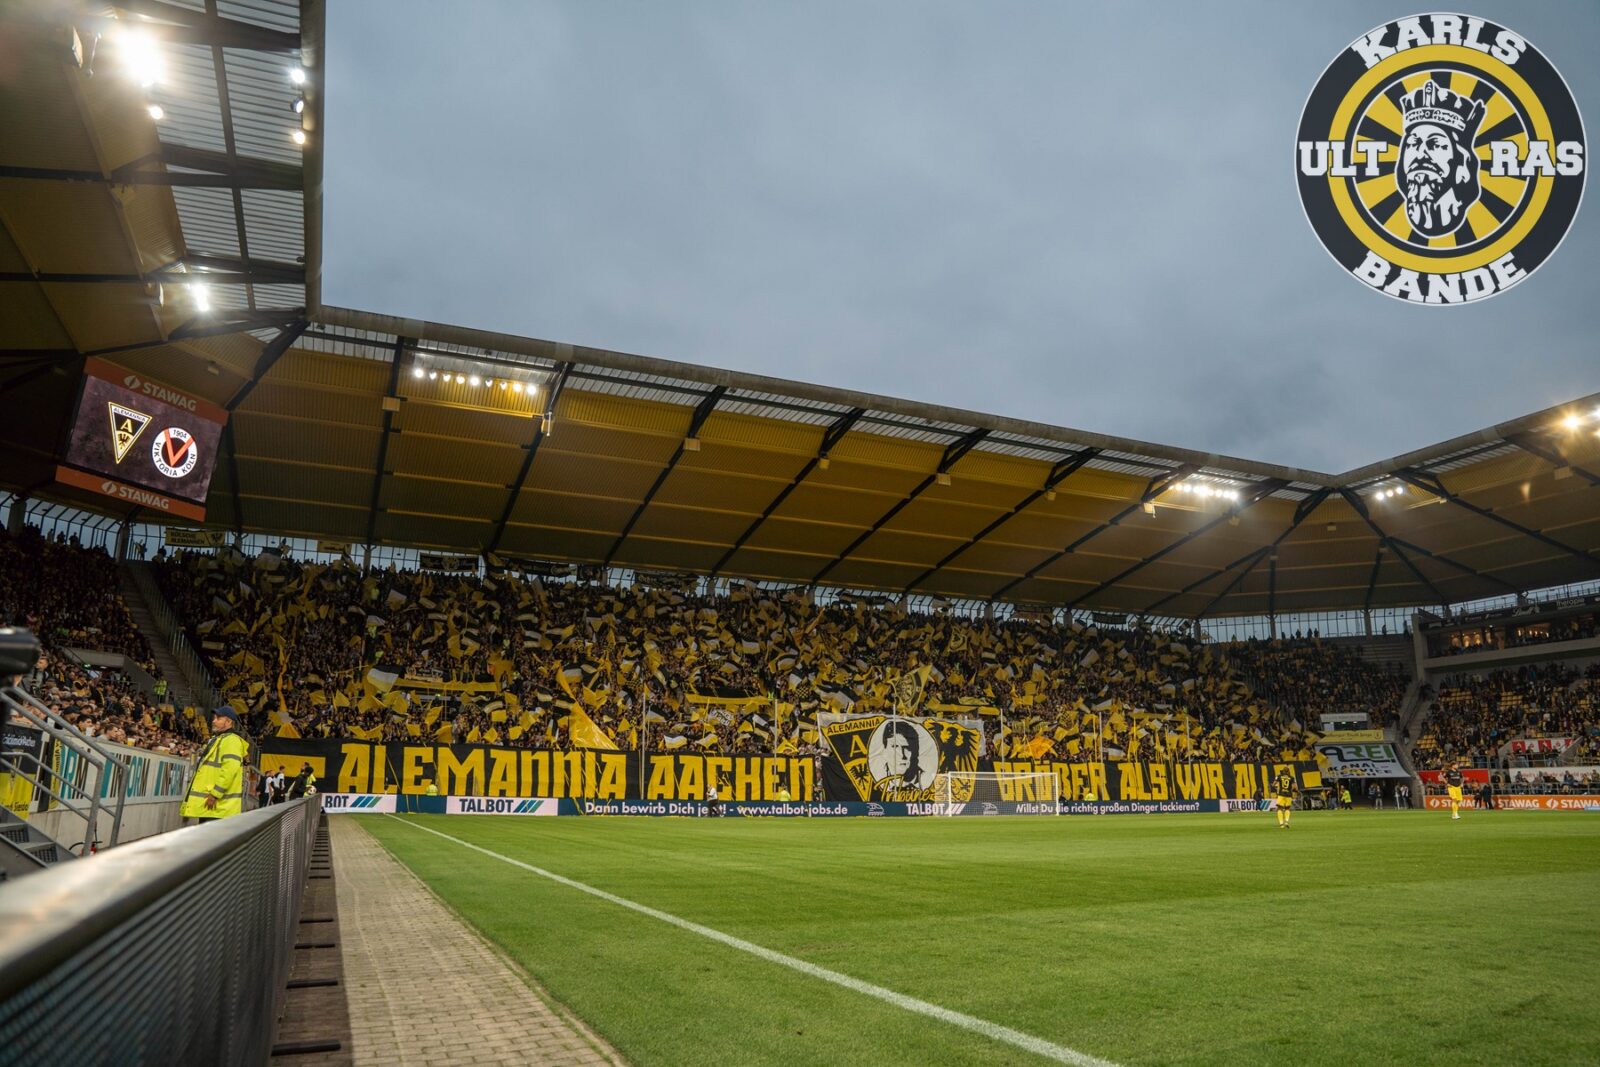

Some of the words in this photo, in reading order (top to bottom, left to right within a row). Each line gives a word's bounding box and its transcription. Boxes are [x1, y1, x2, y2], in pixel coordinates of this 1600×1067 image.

[143, 382, 198, 412] STAWAG
[173, 429, 188, 440] 1904
[154, 442, 178, 477] VIKTORIA
[119, 486, 170, 510] STAWAG
[827, 719, 881, 734] ALEMANNIA
[337, 743, 627, 800] ALEMANNIA
[647, 754, 813, 801] AACHEN
[1117, 762, 1169, 801] ALS
[1175, 762, 1227, 800] WIR
[1281, 777, 1290, 789] 19
[459, 799, 514, 813] TALBOT
[585, 802, 618, 814] Dann
[622, 802, 666, 814] bewirb
[669, 802, 695, 814] Dich
[737, 803, 848, 817] www.talbot-jobs.de
[906, 803, 945, 815] TALBOT
[1041, 803, 1054, 813] Du
[1071, 802, 1098, 815] richtig
[1100, 802, 1129, 815] großen
[1131, 802, 1158, 814] Dinger
[1160, 802, 1199, 812] lackieren?
[1226, 800, 1256, 811] TALBOT
[1499, 799, 1539, 809] STAWAG
[1560, 799, 1600, 808] STAWA
